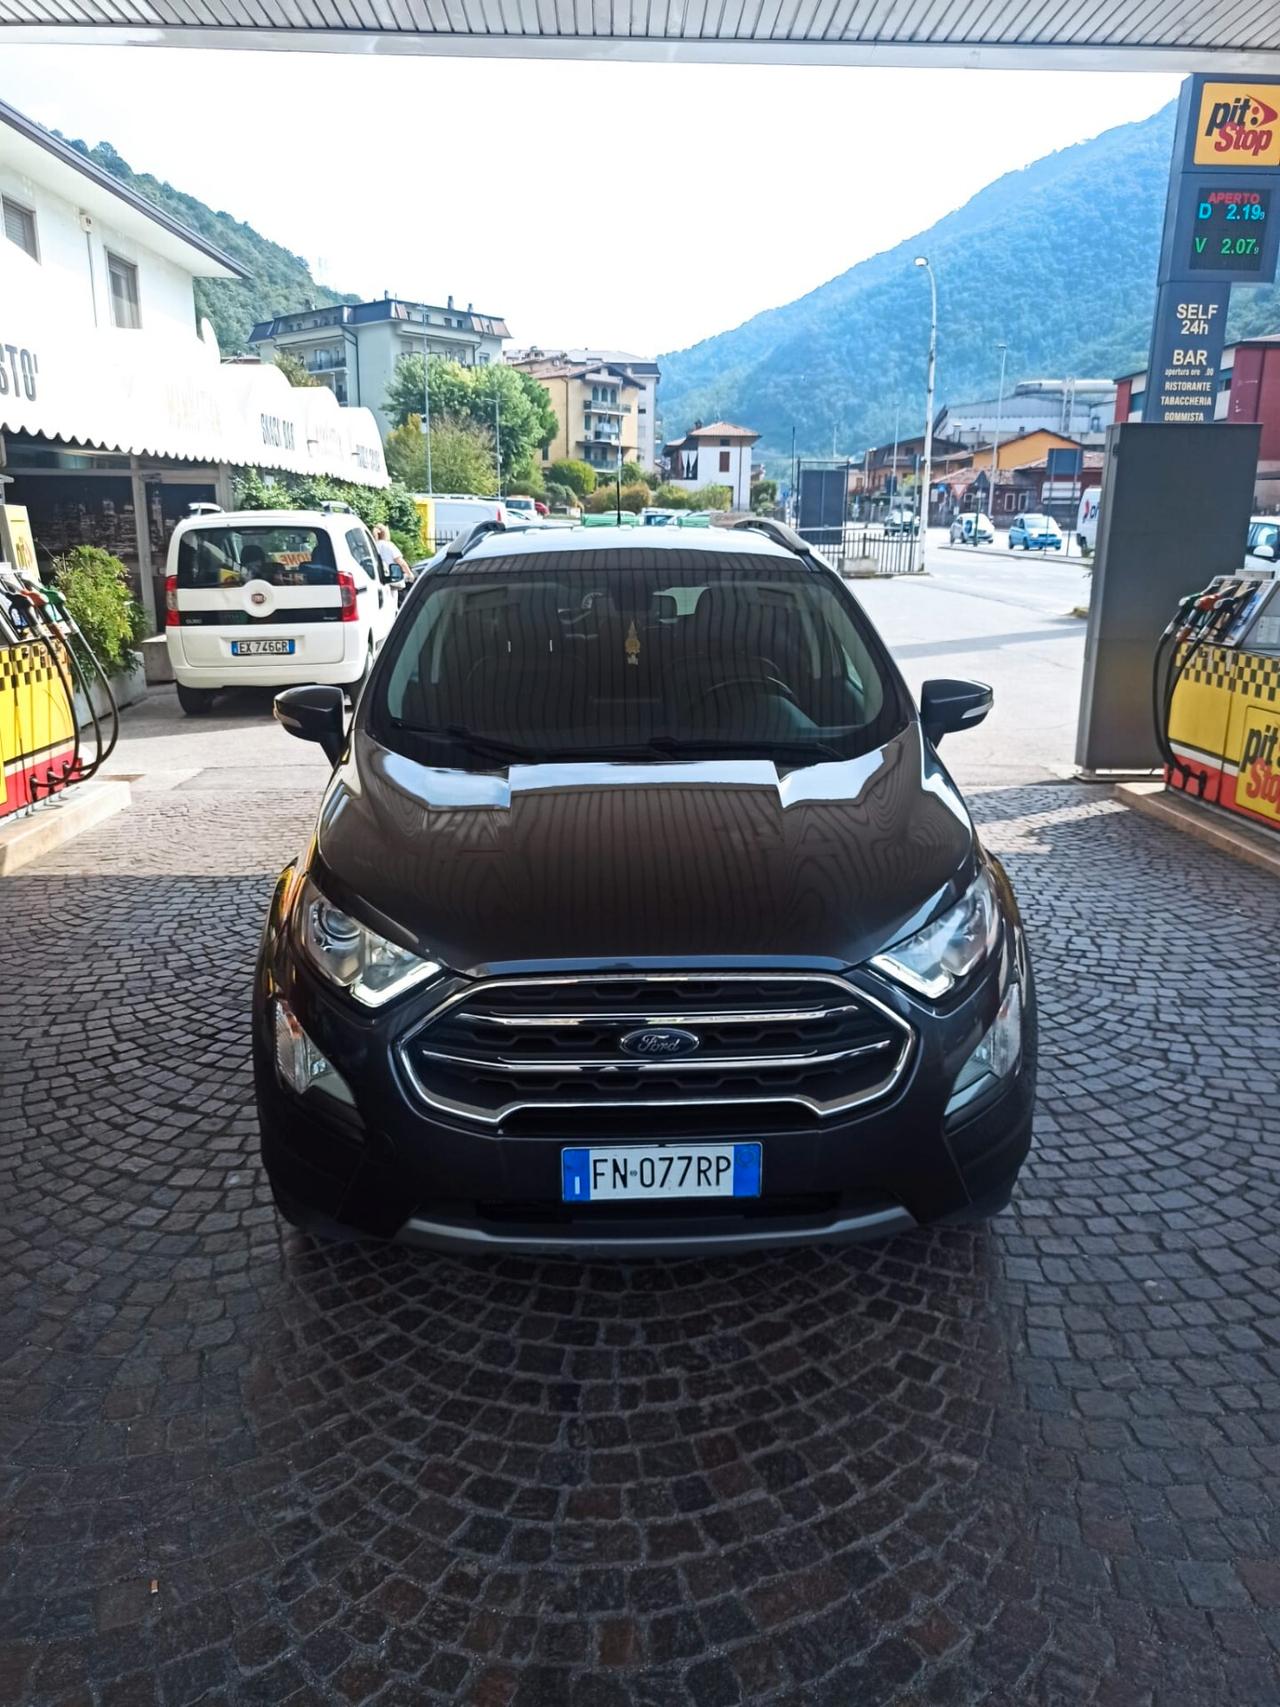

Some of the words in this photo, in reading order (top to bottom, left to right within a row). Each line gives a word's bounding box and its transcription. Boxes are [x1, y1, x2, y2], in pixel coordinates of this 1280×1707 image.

[1205, 97, 1250, 136] pit
[1214, 122, 1273, 156] Stop
[1207, 192, 1260, 204] APERTO
[1199, 203, 1212, 219] D
[1194, 238, 1207, 253] V
[1176, 304, 1219, 319] SELF
[1181, 320, 1209, 335] 24h
[1172, 350, 1208, 366] BAR
[1164, 368, 1190, 377] apertura
[1164, 382, 1212, 391] RISTORANTE
[1160, 396, 1212, 406] TABACCHERIA
[1164, 412, 1205, 422] GOMMISTA
[239, 642, 251, 653] EX
[1240, 724, 1278, 773] pit
[638, 1034, 681, 1052] Ford
[592, 1157, 628, 1190] FN
[639, 1156, 731, 1188] 077RP
